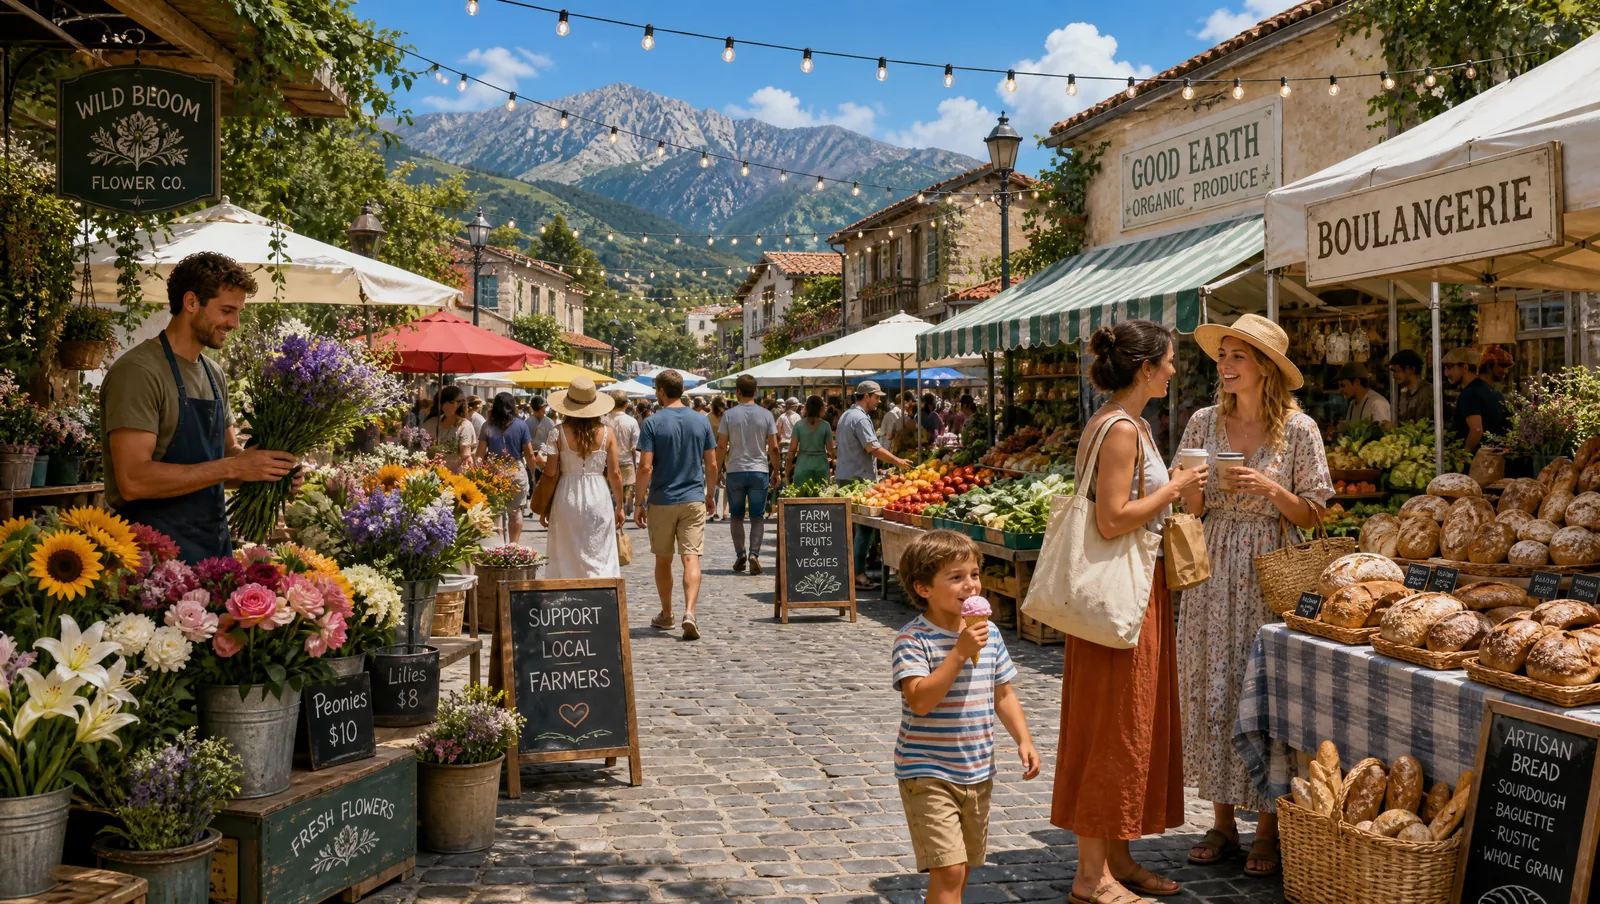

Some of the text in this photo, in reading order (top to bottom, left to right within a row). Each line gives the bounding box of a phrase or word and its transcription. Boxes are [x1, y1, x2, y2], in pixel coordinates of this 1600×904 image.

[75, 85, 200, 122] WILD BLOOM
[1131, 121, 1260, 190] GOOD EARTH
[92, 176, 186, 190] FLOWER CO.
[1132, 167, 1258, 217] ORGANIC PRODUCE
[1317, 175, 1533, 260] BOULANGERIE
[800, 509, 830, 521] FARM
[800, 522, 833, 533] FRESH
[800, 536, 833, 547] FRUITS
[812, 547, 820, 556] &
[795, 557, 838, 568] VEGGIES
[528, 606, 602, 627] SUPPORT
[542, 639, 596, 659] LOCAL
[388, 665, 427, 685] Lilies
[529, 668, 611, 693] FARMERS
[312, 690, 367, 719] Peonies
[397, 688, 419, 709] $8
[329, 720, 358, 747] $10
[1504, 726, 1573, 761] ARTISAN
[1511, 753, 1560, 782] BREAD
[291, 797, 395, 857] FRESH FLOWERS
[1525, 858, 1564, 884] GRAIN
